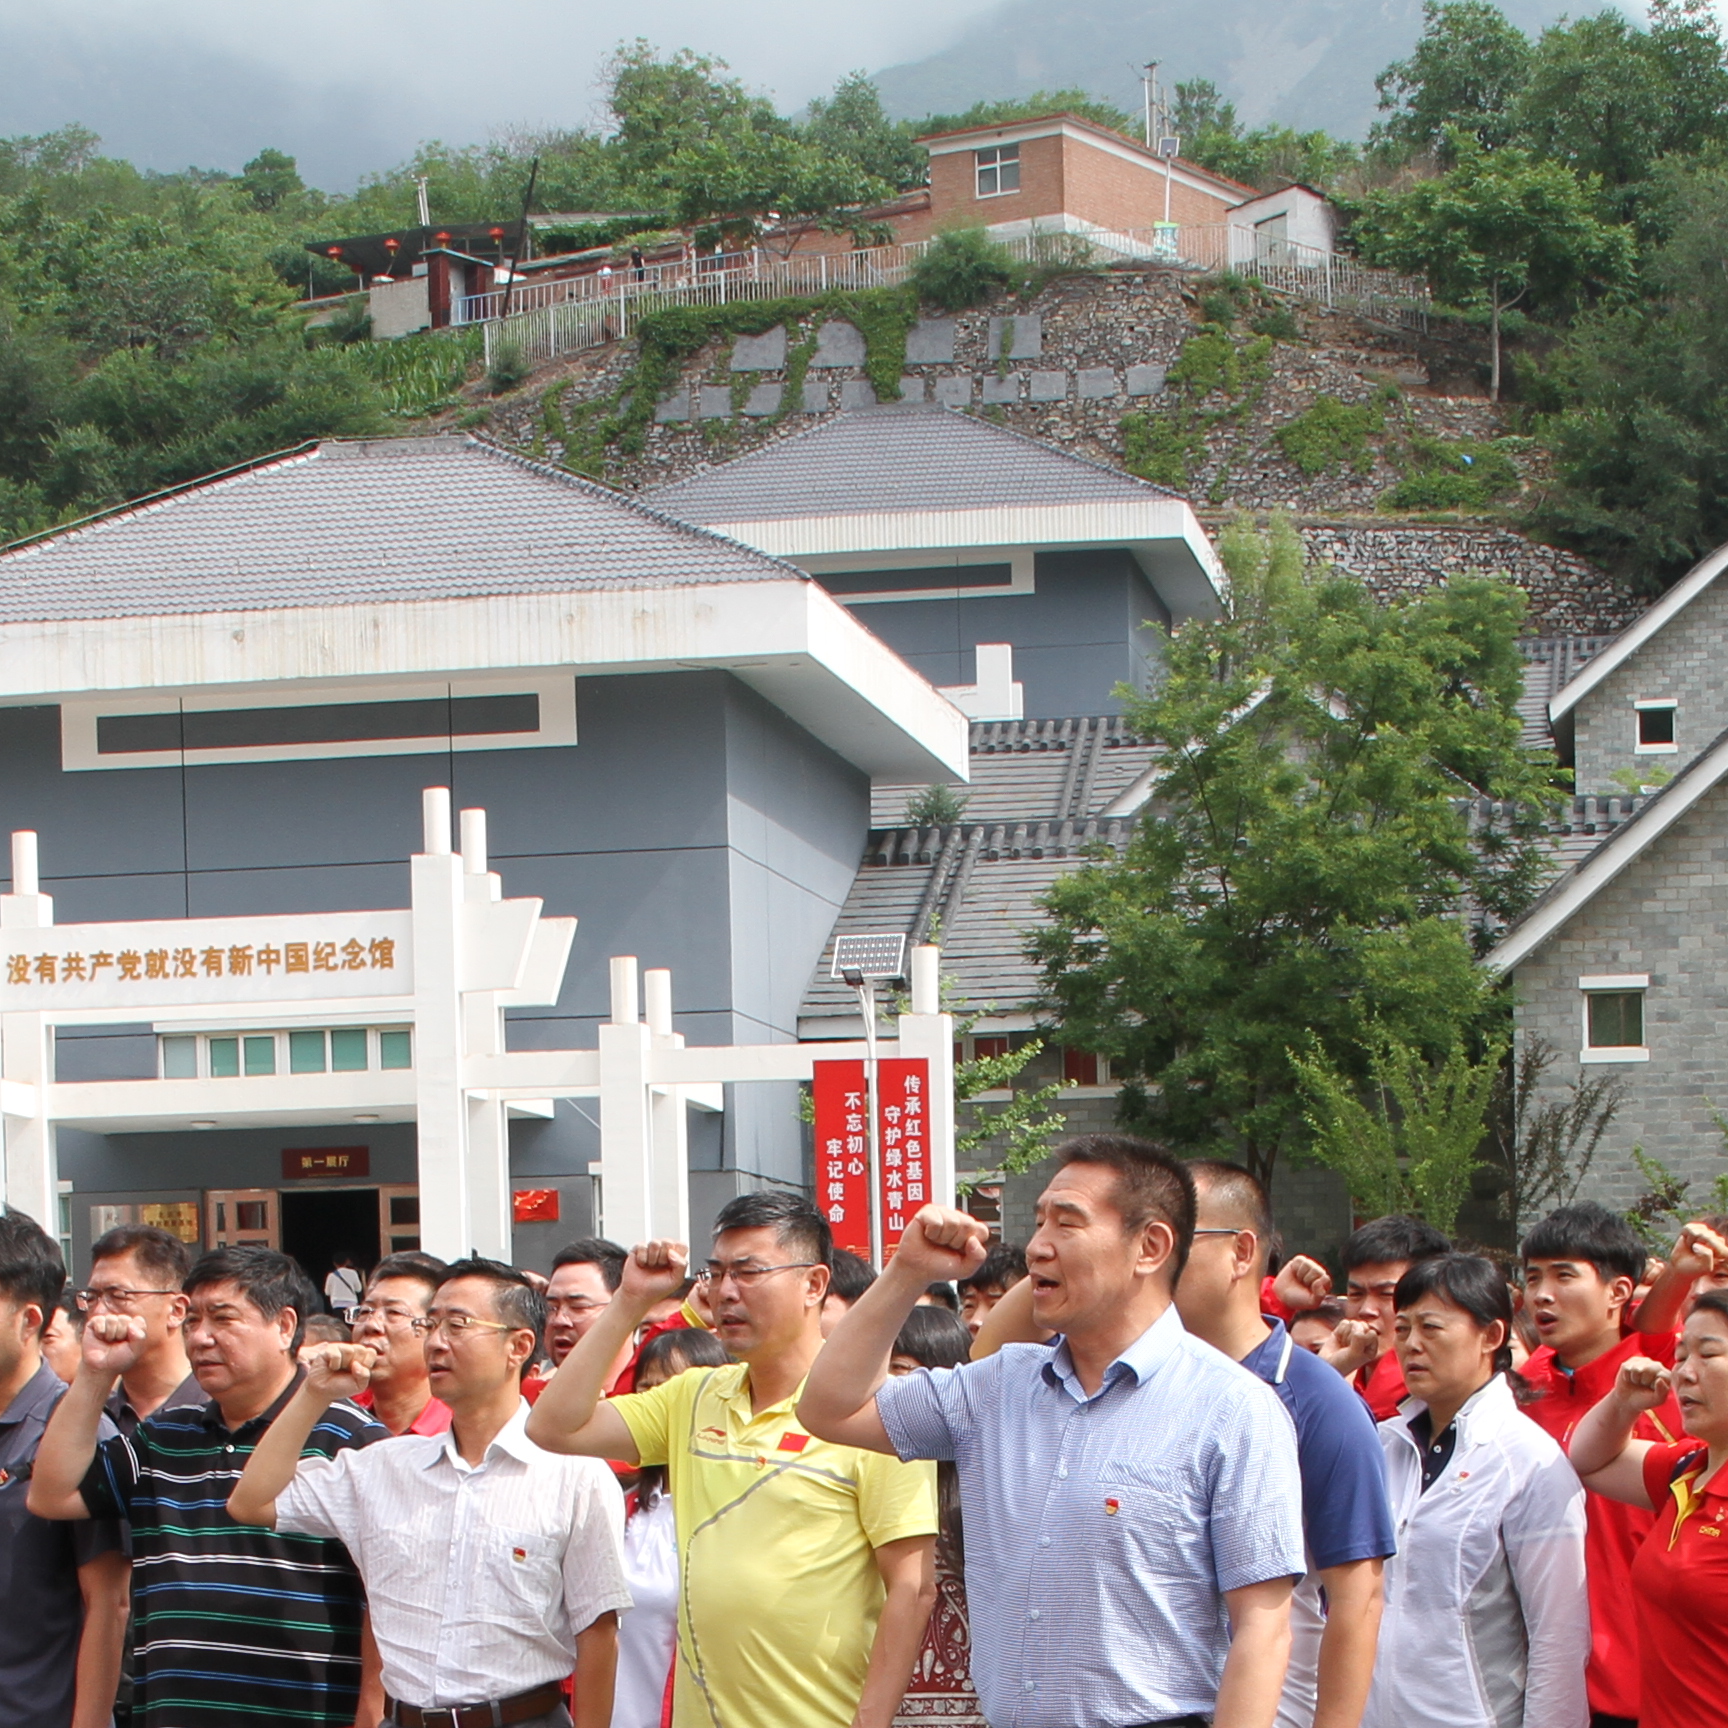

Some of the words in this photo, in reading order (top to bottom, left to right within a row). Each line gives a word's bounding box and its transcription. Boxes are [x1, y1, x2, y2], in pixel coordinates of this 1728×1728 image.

[6, 936, 396, 985] 没有共产党就没有新中国纪念馆
[844, 1091, 865, 1176] 不忘初心
[884, 1105, 905, 1231] 守护绿水青山
[903, 1074, 924, 1202] 传承红色基因
[826, 1138, 846, 1224] 牢记使命
